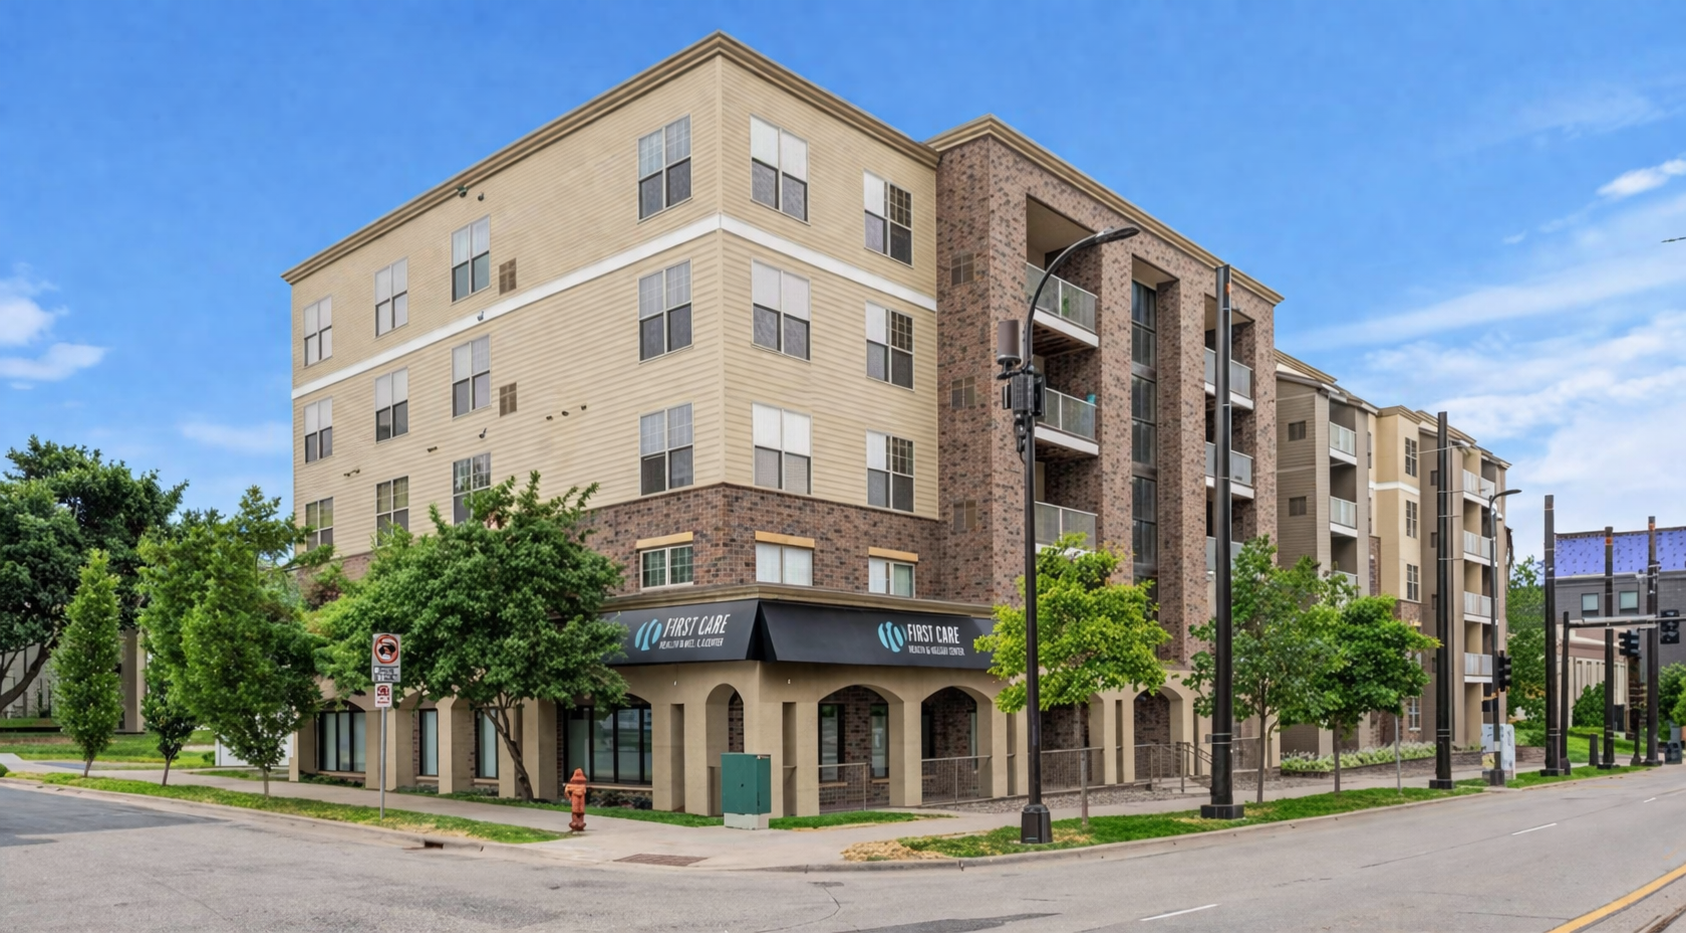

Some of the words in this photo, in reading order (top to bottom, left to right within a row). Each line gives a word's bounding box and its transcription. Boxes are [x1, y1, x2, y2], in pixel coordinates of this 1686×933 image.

[663, 616, 698, 637] FIRST
[698, 614, 731, 635] CARE
[907, 624, 933, 643] FIRST
[935, 626, 960, 644] CARE
